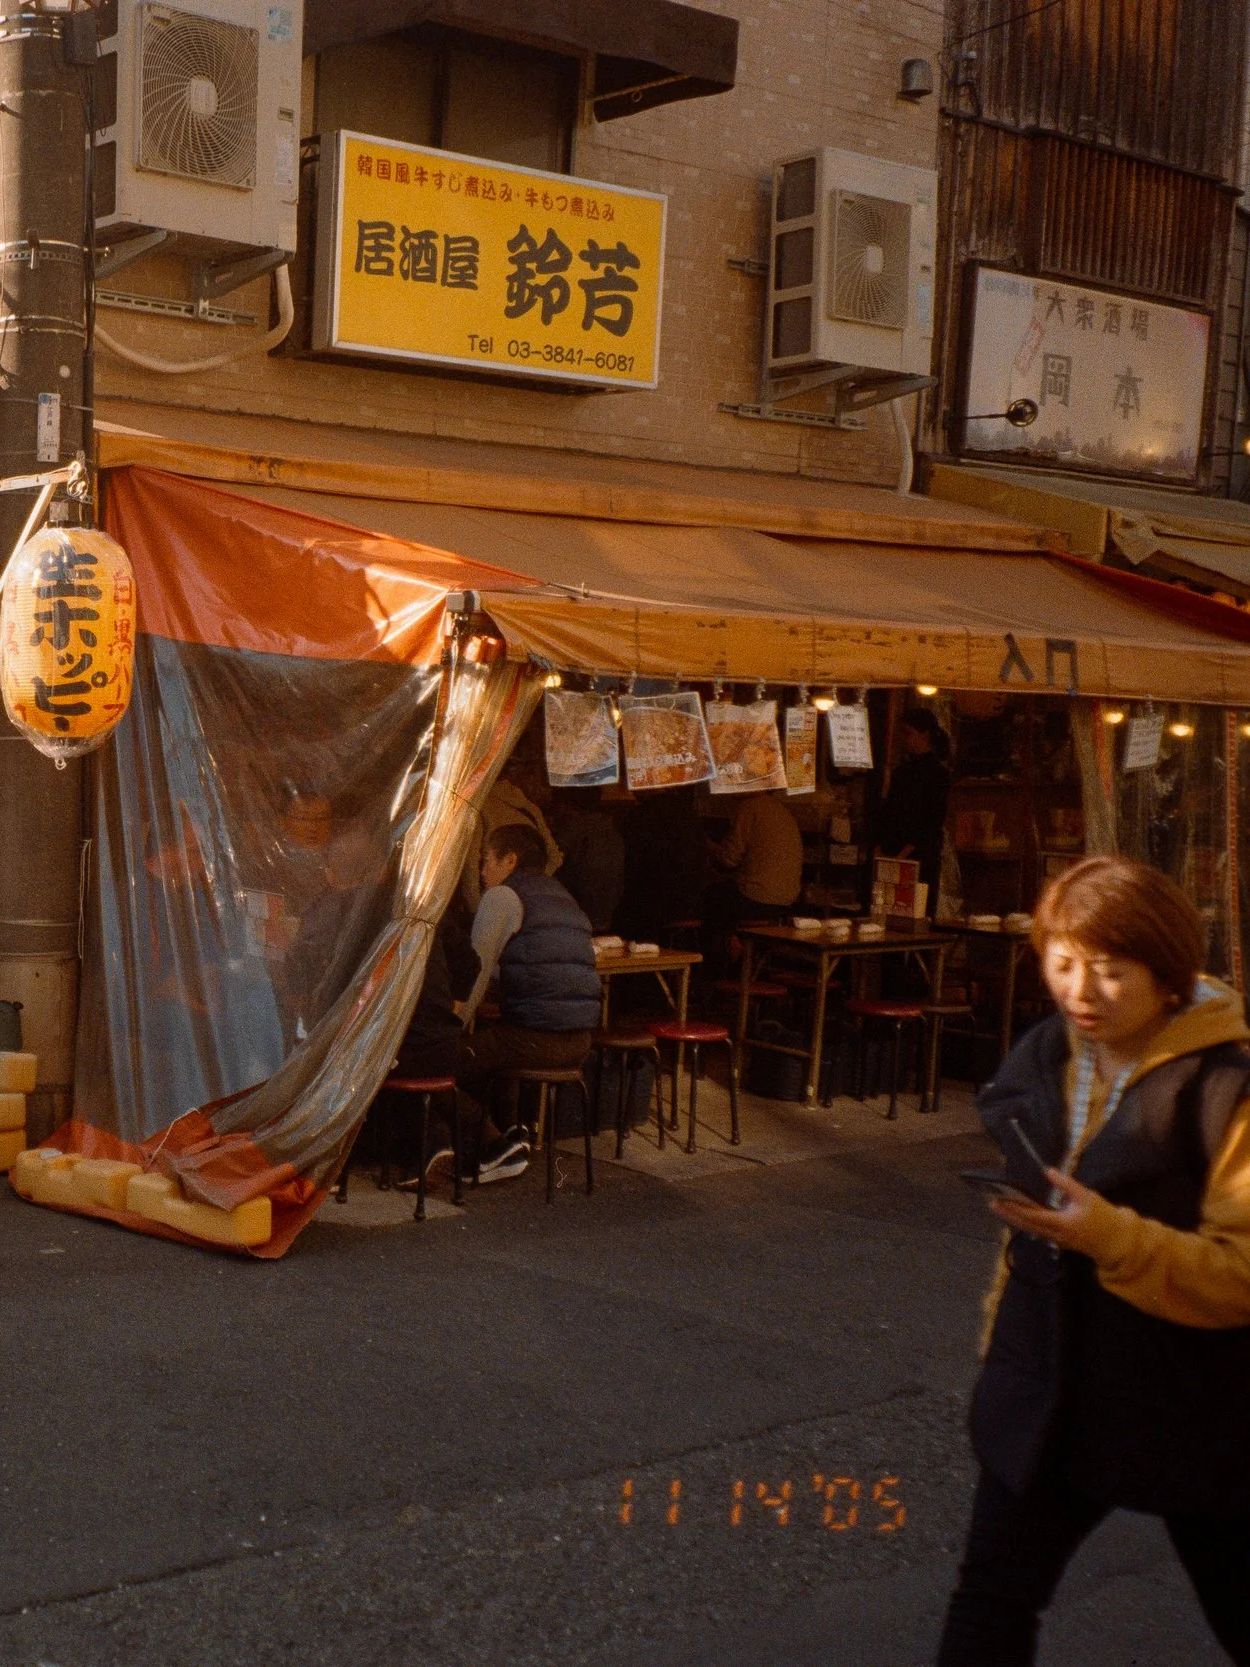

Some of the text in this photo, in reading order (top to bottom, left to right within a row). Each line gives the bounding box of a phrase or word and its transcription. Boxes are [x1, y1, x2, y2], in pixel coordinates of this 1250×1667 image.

[355, 219, 641, 337] 居酒屋 鈴芳
[467, 334, 635, 373] Tel 03-3841-6081
